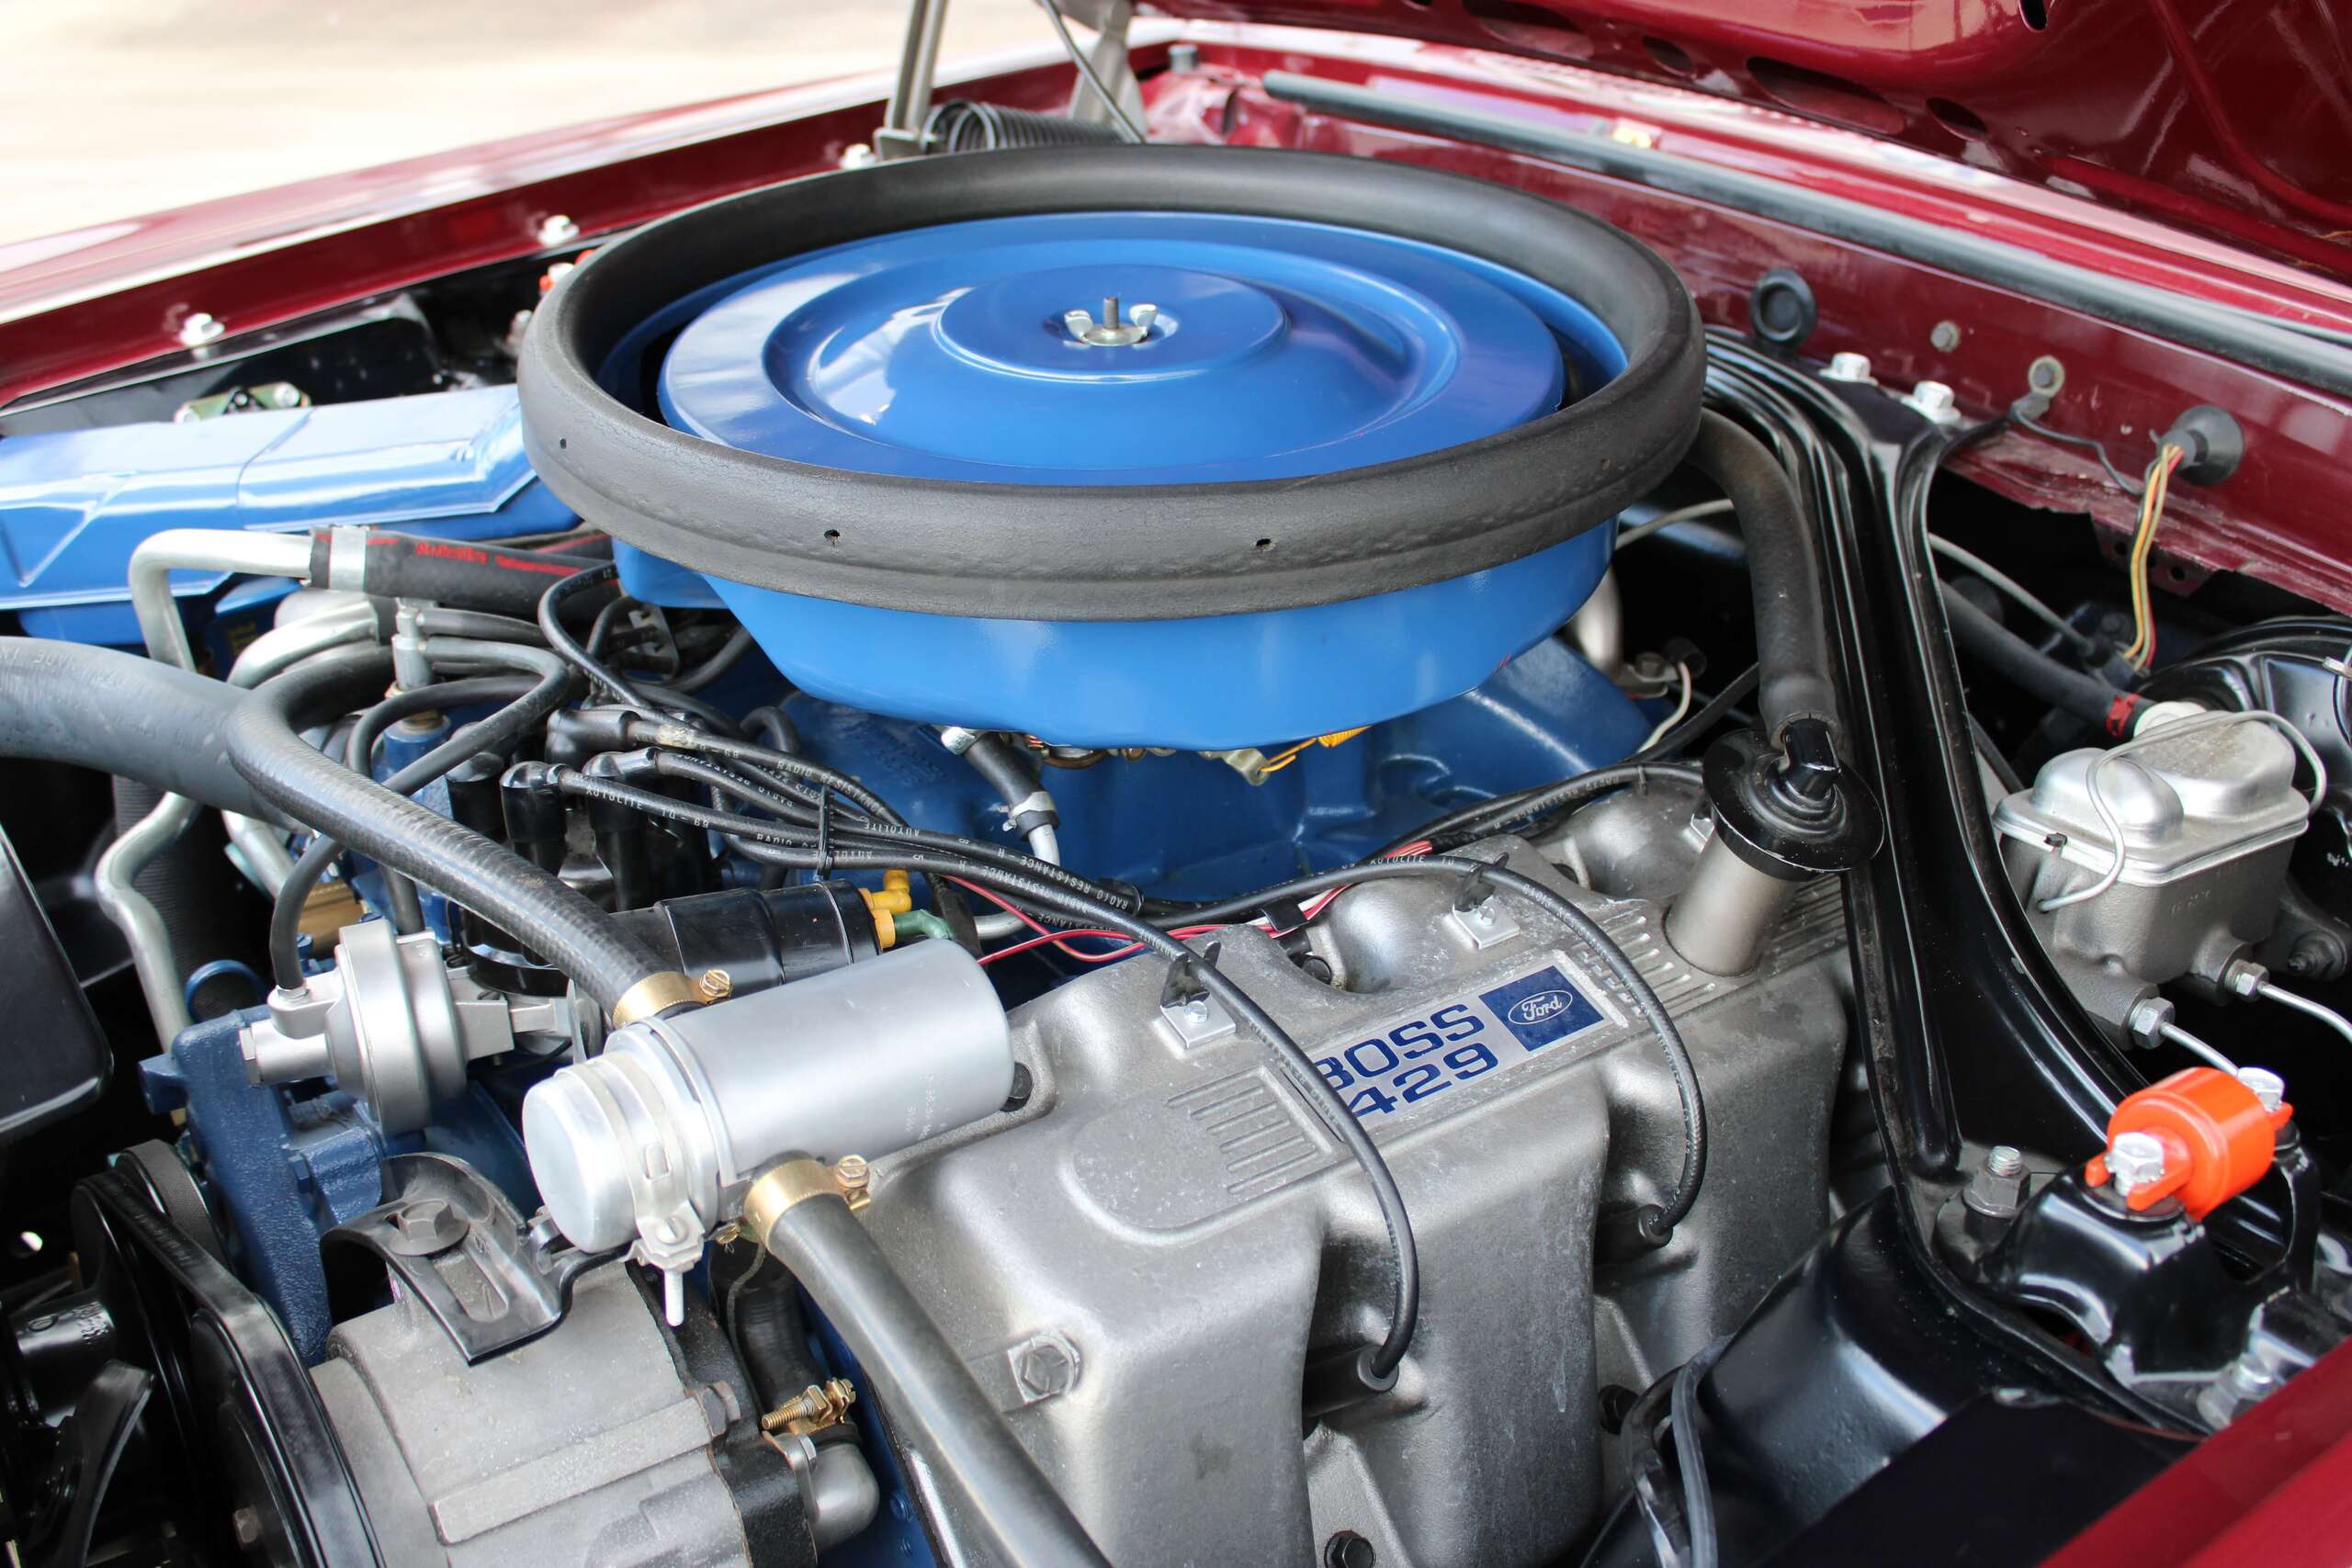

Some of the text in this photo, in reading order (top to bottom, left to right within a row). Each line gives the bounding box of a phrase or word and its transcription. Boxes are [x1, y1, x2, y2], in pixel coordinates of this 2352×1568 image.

[777, 761, 813, 777] RADIO
[586, 784, 643, 810] AUTOLITE
[865, 822, 920, 838] AUTOLITE
[1370, 854, 1425, 865] AUTOLITE
[1019, 856, 1091, 895] RESISTANCE
[1095, 888, 1129, 910] RADIO
[1521, 995, 1563, 1021] Ford
[1313, 1004, 1485, 1091] BOSS
[1347, 1043, 1498, 1117] 429
